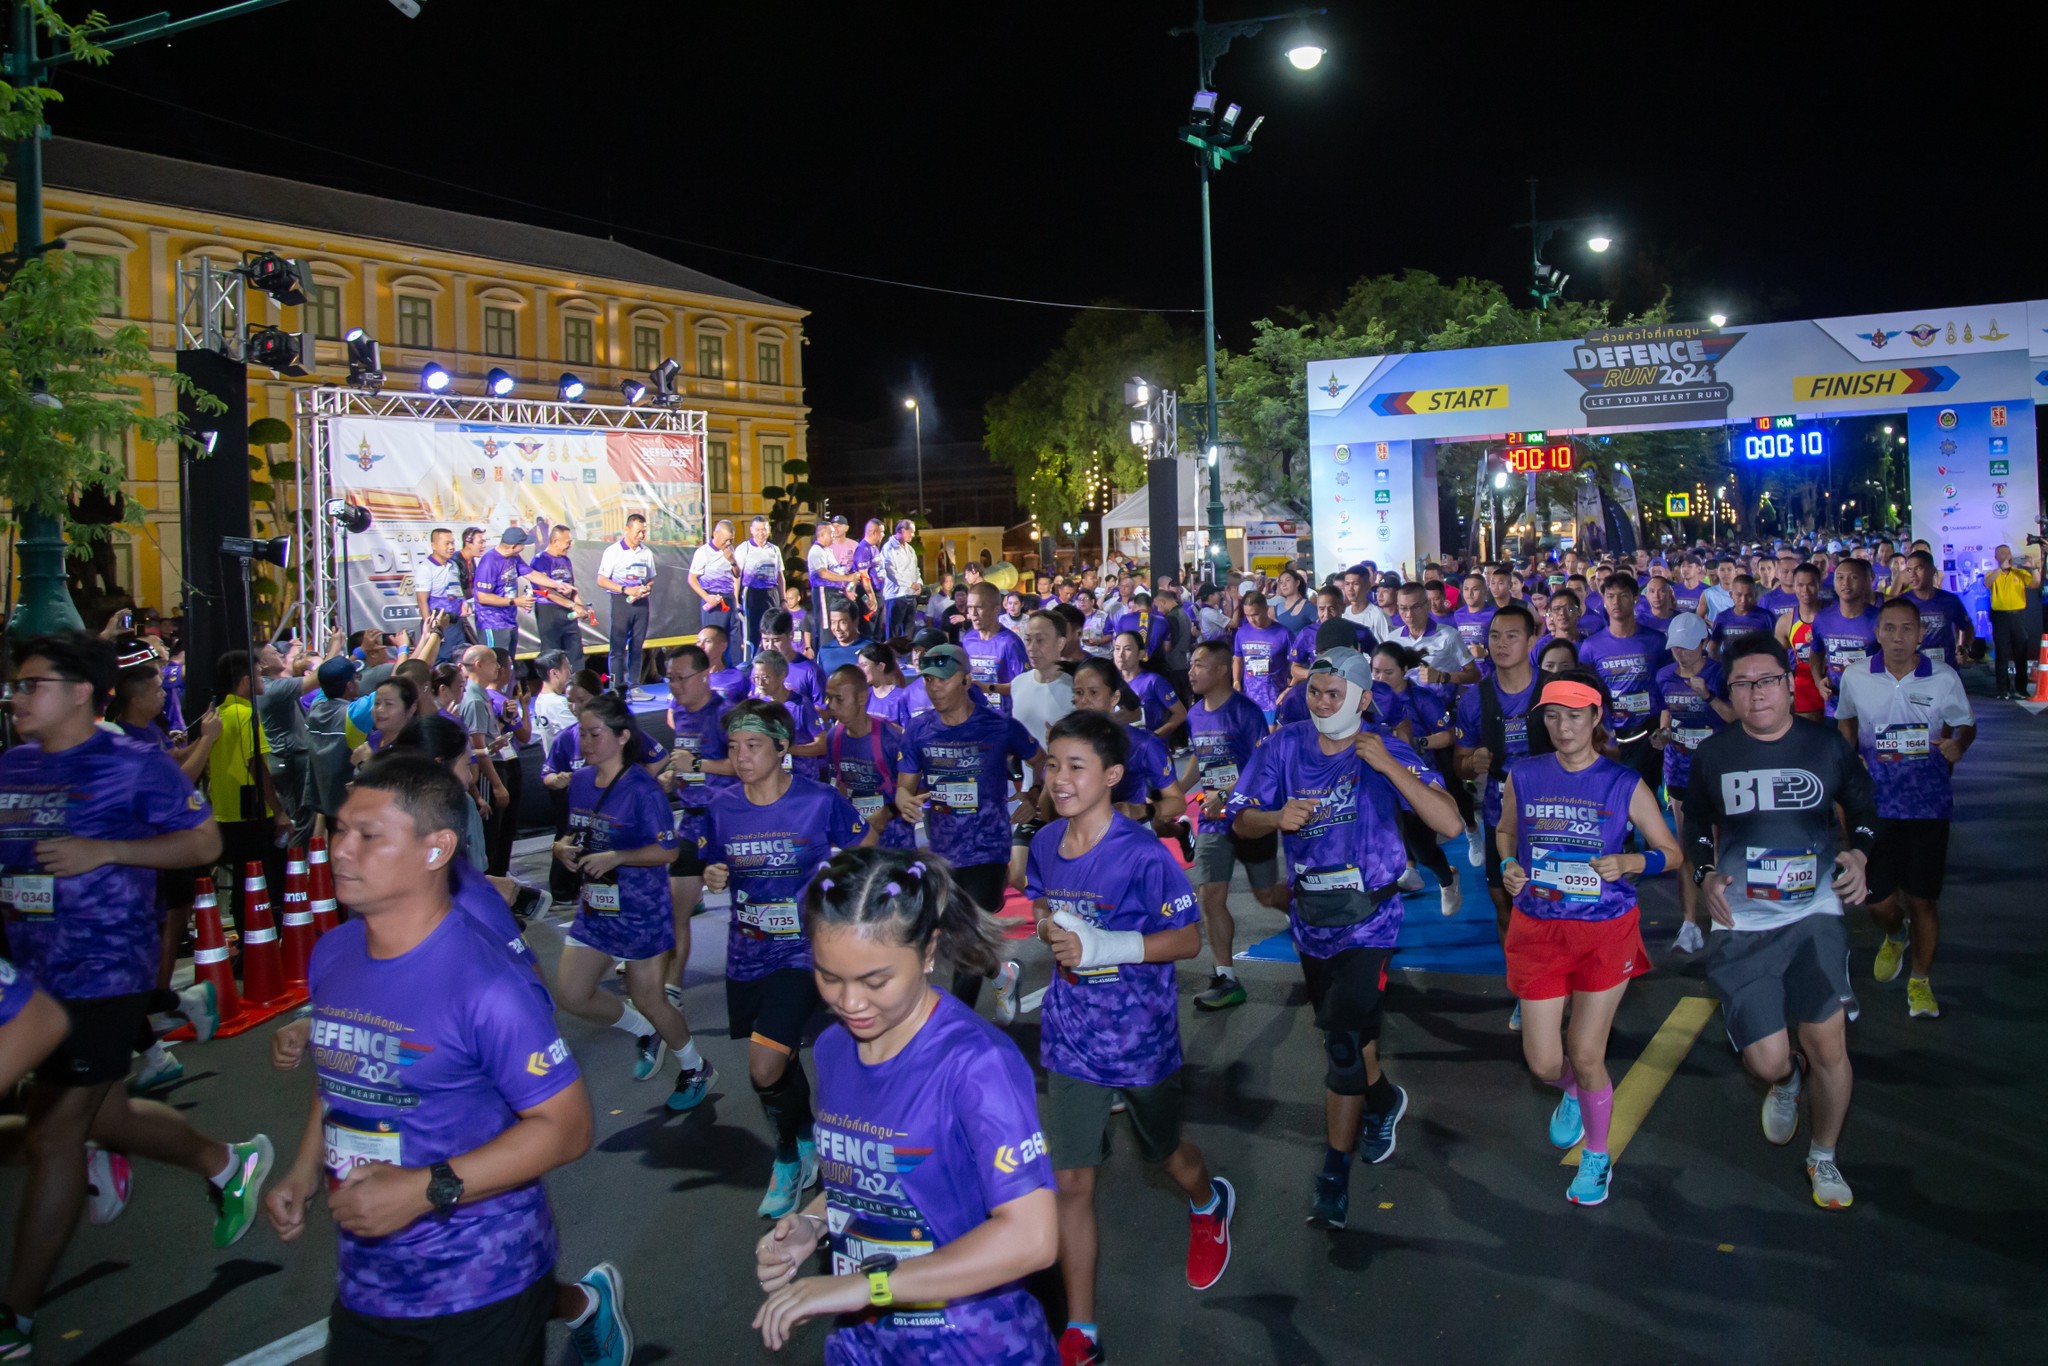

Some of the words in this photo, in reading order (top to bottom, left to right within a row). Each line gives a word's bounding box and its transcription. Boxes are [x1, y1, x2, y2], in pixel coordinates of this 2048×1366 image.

[1577, 340, 1706, 370] DEFENCE
[1603, 366, 1658, 388] RUN
[1659, 363, 1712, 386] 2024
[1810, 372, 1897, 398] FINISH
[1428, 388, 1498, 411] START
[1592, 397, 1612, 406] LET
[1617, 395, 1648, 404] YOUR
[1654, 392, 1691, 402] HEART
[1758, 417, 1770, 429] 10
[1508, 432, 1522, 443] 21
[390, 608, 408, 617] LET
[1823, 637, 1865, 648] DEFENCE
[1602, 657, 1646, 669] DEFENCE
[1905, 739, 1926, 748] 1644
[922, 746, 980, 759] DEFENCE
[957, 756, 981, 768] 2024
[1219, 774, 1237, 783] 1528
[953, 793, 974, 802] 1725
[1525, 804, 1598, 823] DEFENCE
[1535, 818, 1569, 831] RUN
[1568, 820, 1601, 836] 2024
[724, 838, 795, 856] DEFENCE
[767, 853, 798, 867] 2024
[1545, 861, 1556, 871] 3K
[1760, 860, 1776, 870] 10K
[1305, 875, 1320, 884] 10K
[1534, 870, 1541, 879] F
[1787, 870, 1813, 882] 5102
[21, 891, 51, 904] 0343
[595, 895, 615, 904] 1912
[768, 917, 794, 926] 1735
[358, 1056, 404, 1089] 2024
[350, 1087, 382, 1101] HEART
[388, 1094, 412, 1104] RUN
[813, 1122, 898, 1173] EFENCE
[853, 1167, 906, 1200] 2024
[892, 1207, 918, 1218] RUN
